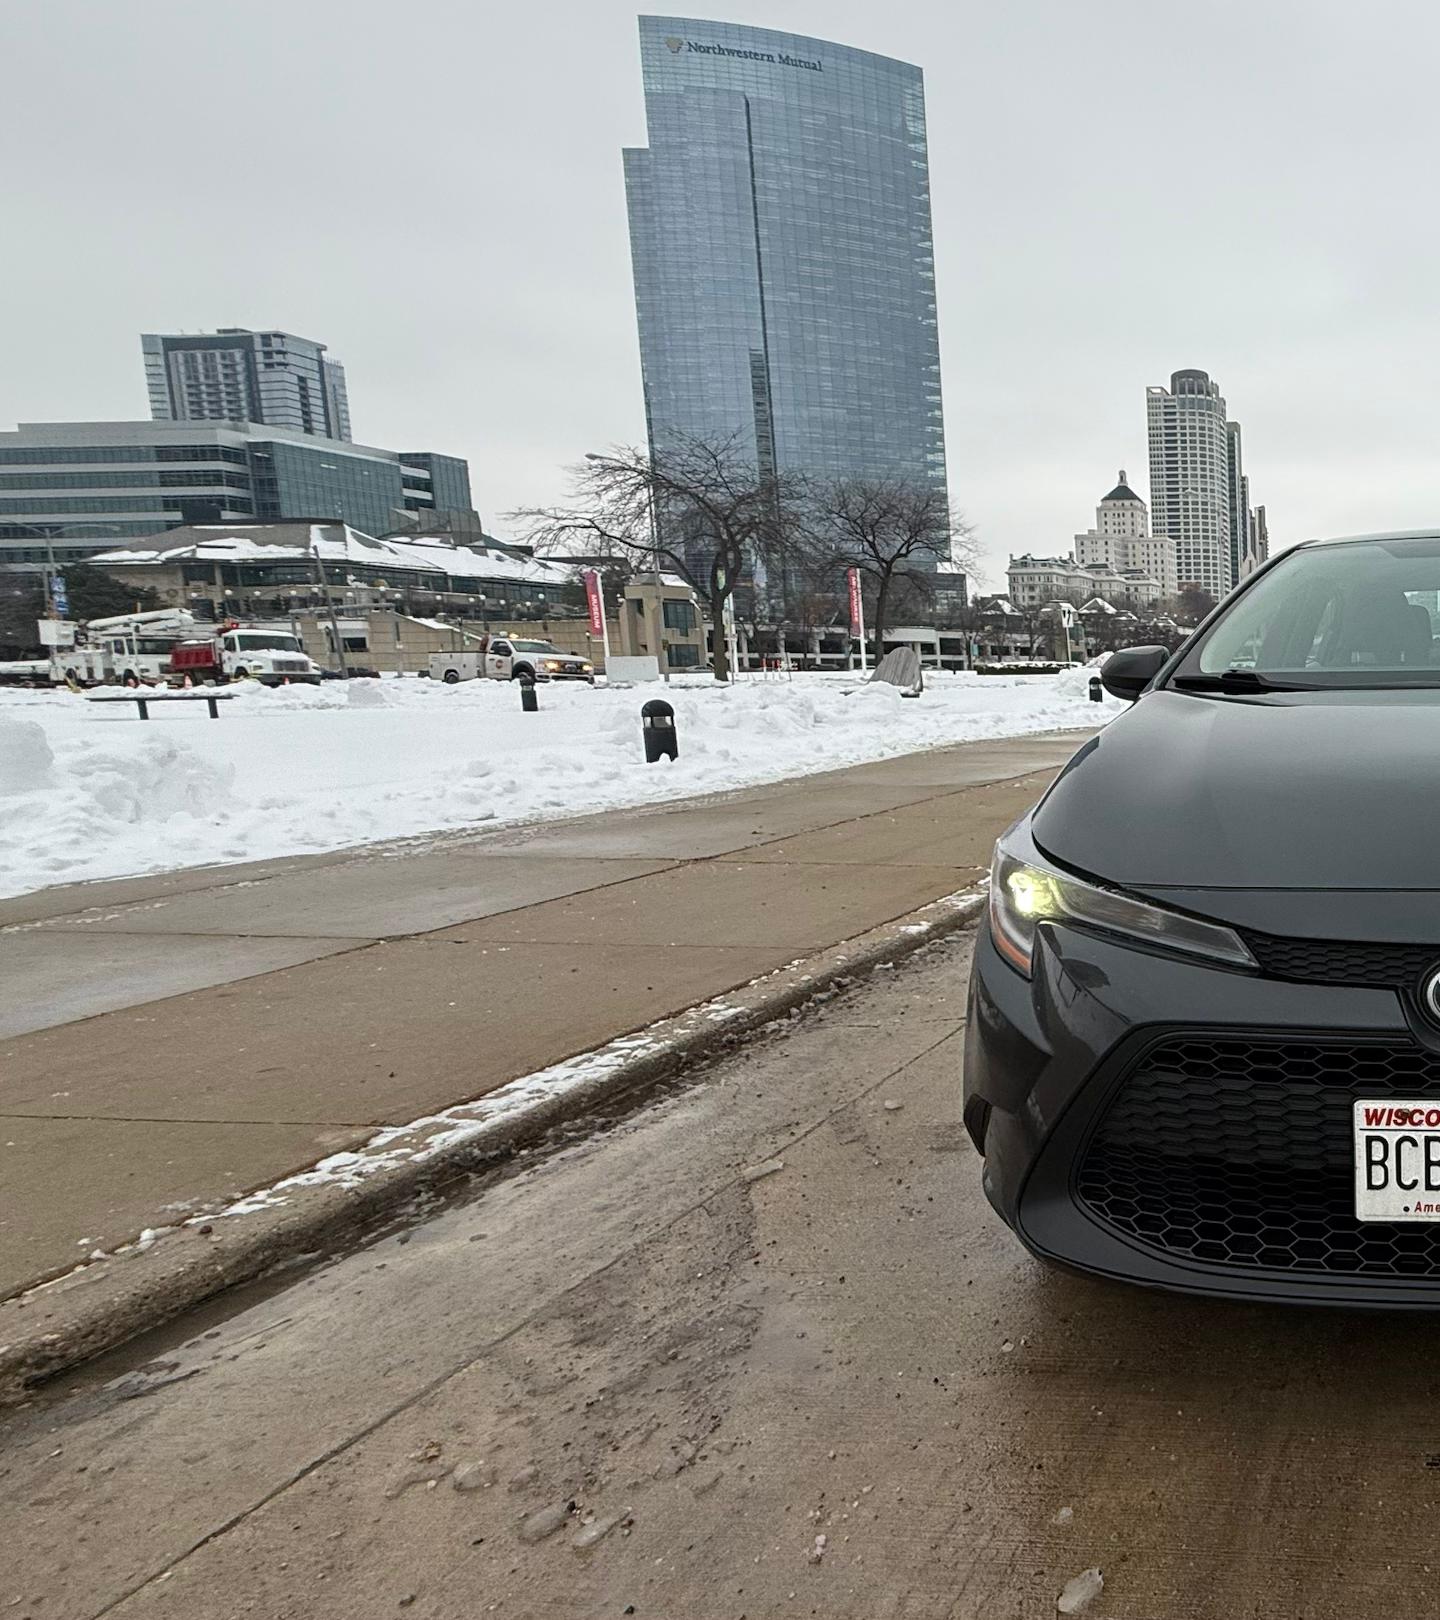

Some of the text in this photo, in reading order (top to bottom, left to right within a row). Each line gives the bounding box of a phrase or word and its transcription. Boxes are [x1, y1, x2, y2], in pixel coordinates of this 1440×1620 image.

[687, 41, 824, 72] Northwestern Mutual
[591, 594, 601, 629] MUSEUM
